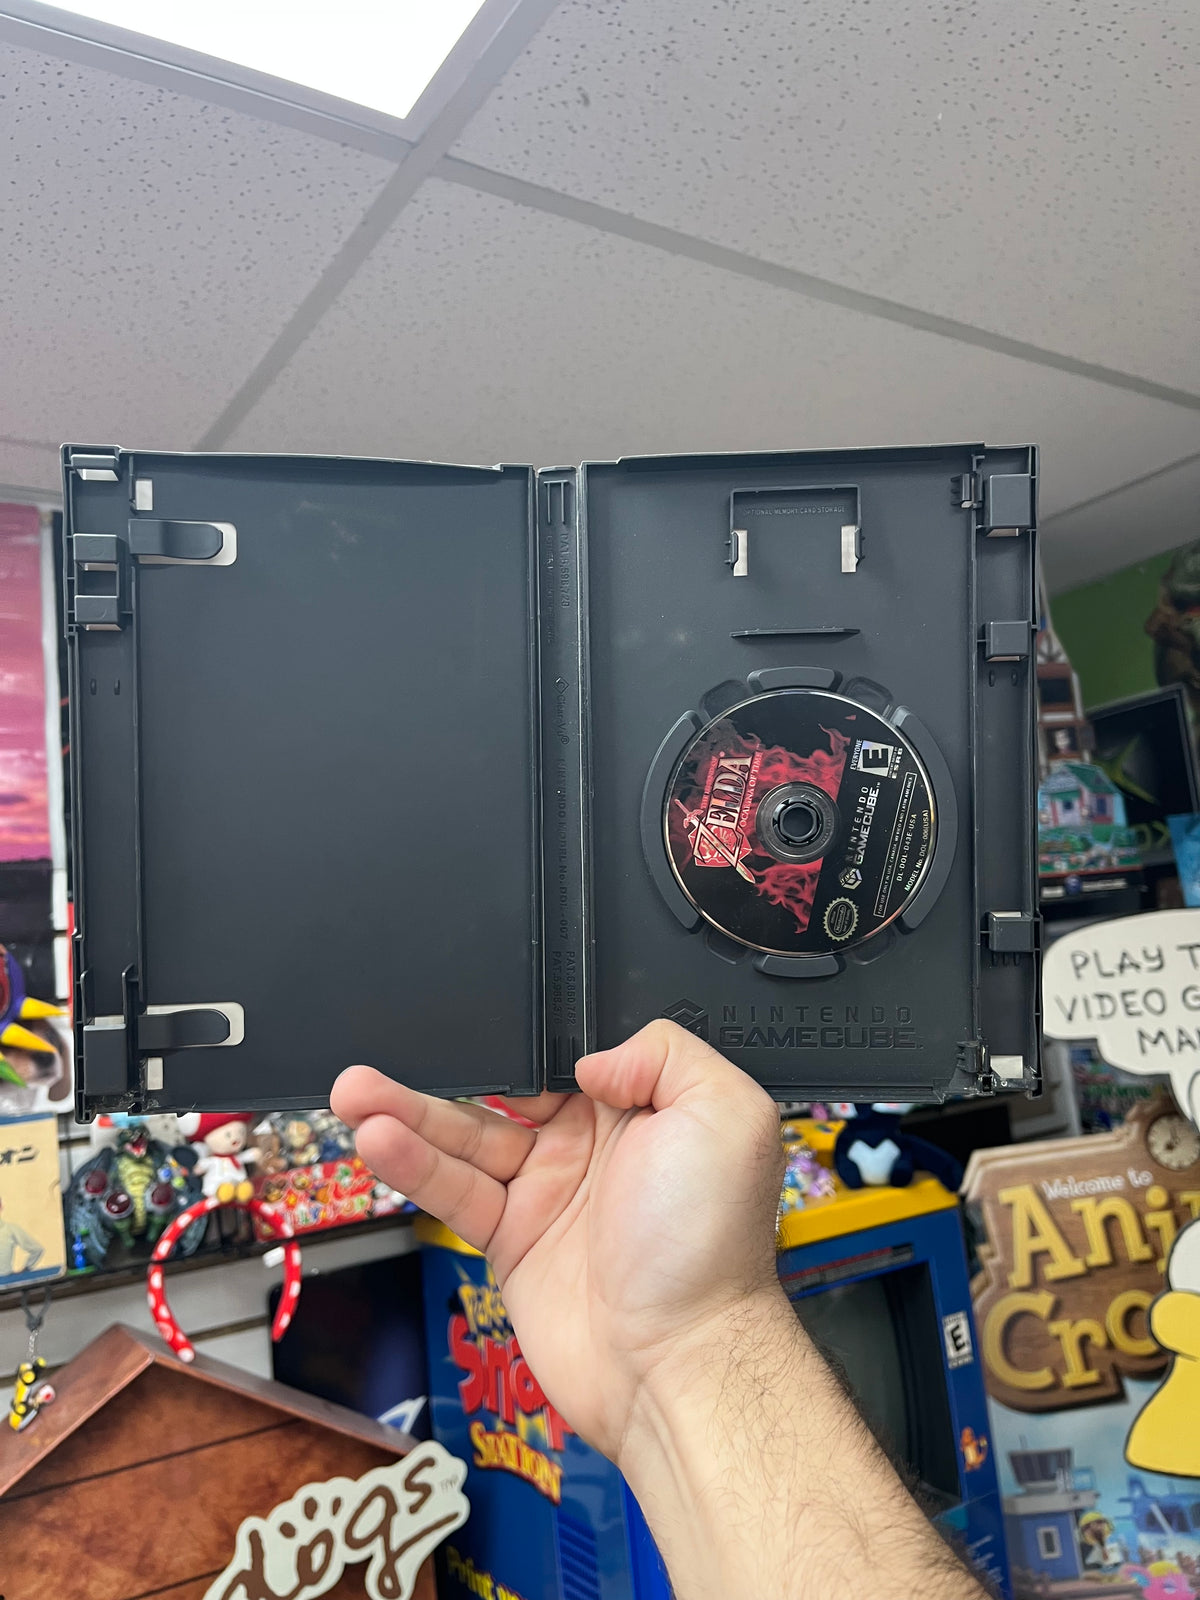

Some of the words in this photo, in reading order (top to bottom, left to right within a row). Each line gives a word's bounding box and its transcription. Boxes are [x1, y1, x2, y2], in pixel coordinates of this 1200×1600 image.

[751, 751, 763, 774] TIME
[850, 740, 862, 770] EVERYONE
[863, 748, 888, 769] E
[891, 748, 903, 779] ESRB
[749, 775, 758, 787] OF
[692, 756, 753, 867] ZELDA
[740, 789, 755, 828] OCARINA
[845, 786, 869, 861] NINTENDO
[904, 869, 920, 892] MODEL
[1070, 944, 1165, 980] PLAY
[721, 1005, 914, 1025] NINTENDO
[1054, 987, 1166, 1022] VIDEO
[1137, 1027, 1200, 1056] MA
[1041, 1175, 1125, 1201] Welcome
[1126, 1166, 1154, 1188] to
